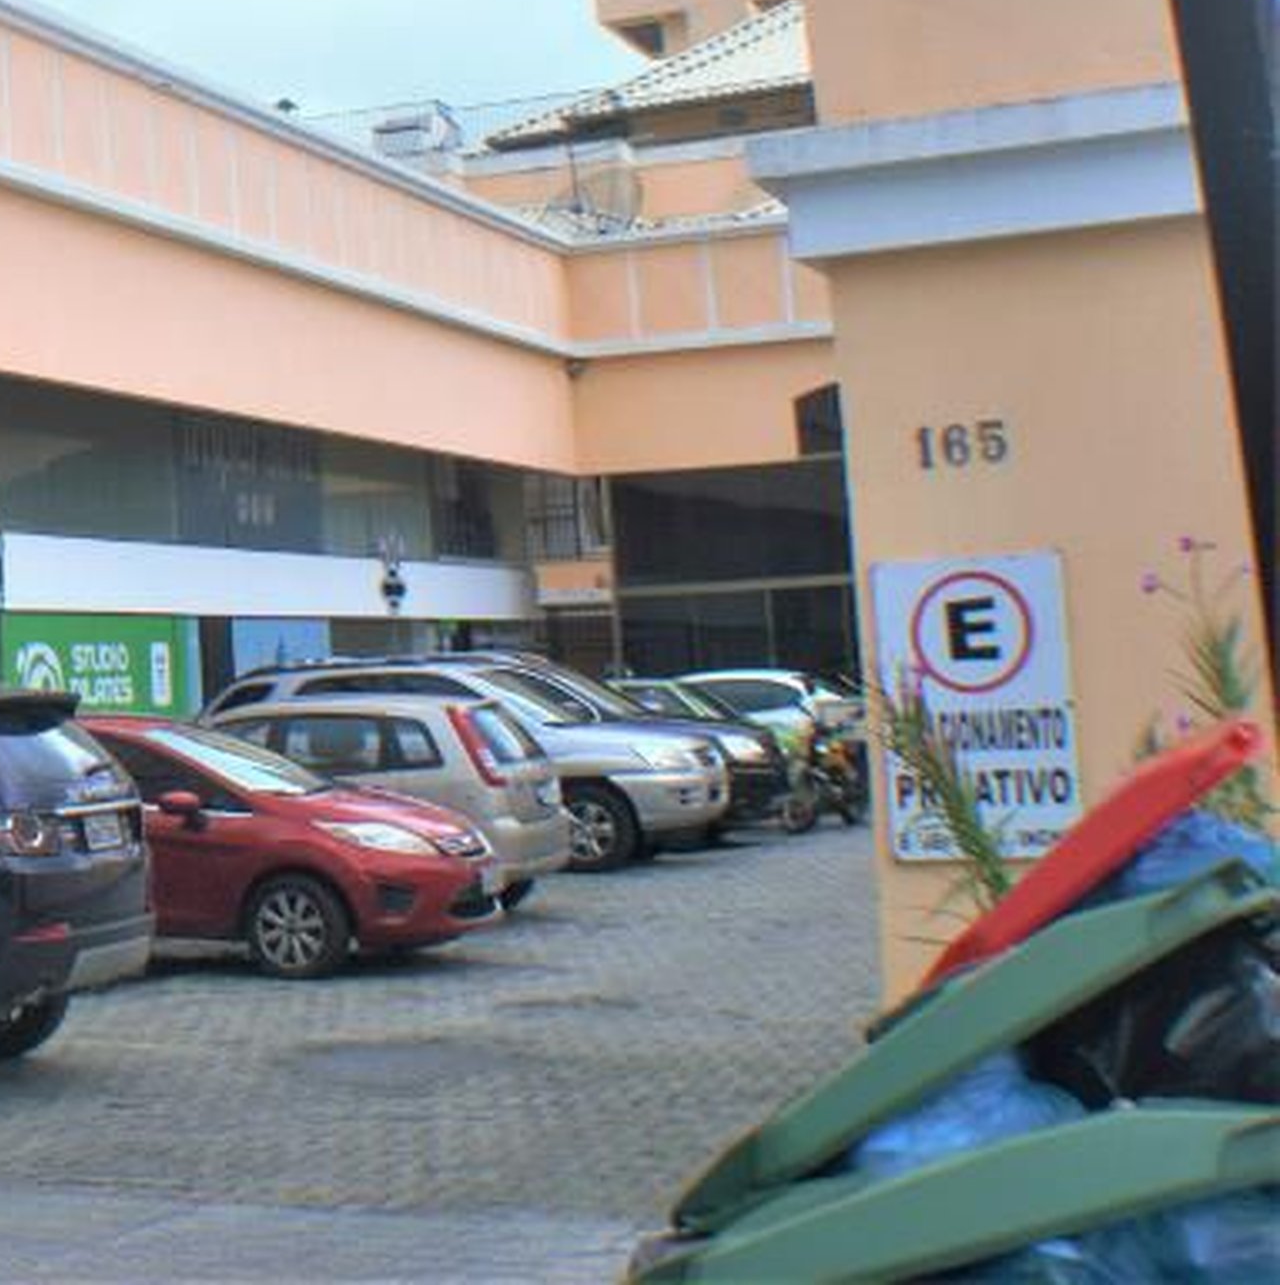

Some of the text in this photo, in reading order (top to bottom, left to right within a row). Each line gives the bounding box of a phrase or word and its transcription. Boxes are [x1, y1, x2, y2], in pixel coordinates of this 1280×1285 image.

[915, 419, 1008, 470] 165
[943, 596, 1001, 662] E
[70, 642, 130, 673] STUDIO
[932, 707, 1067, 754] CIONAMENTO
[895, 768, 1072, 809] PRATIVO
